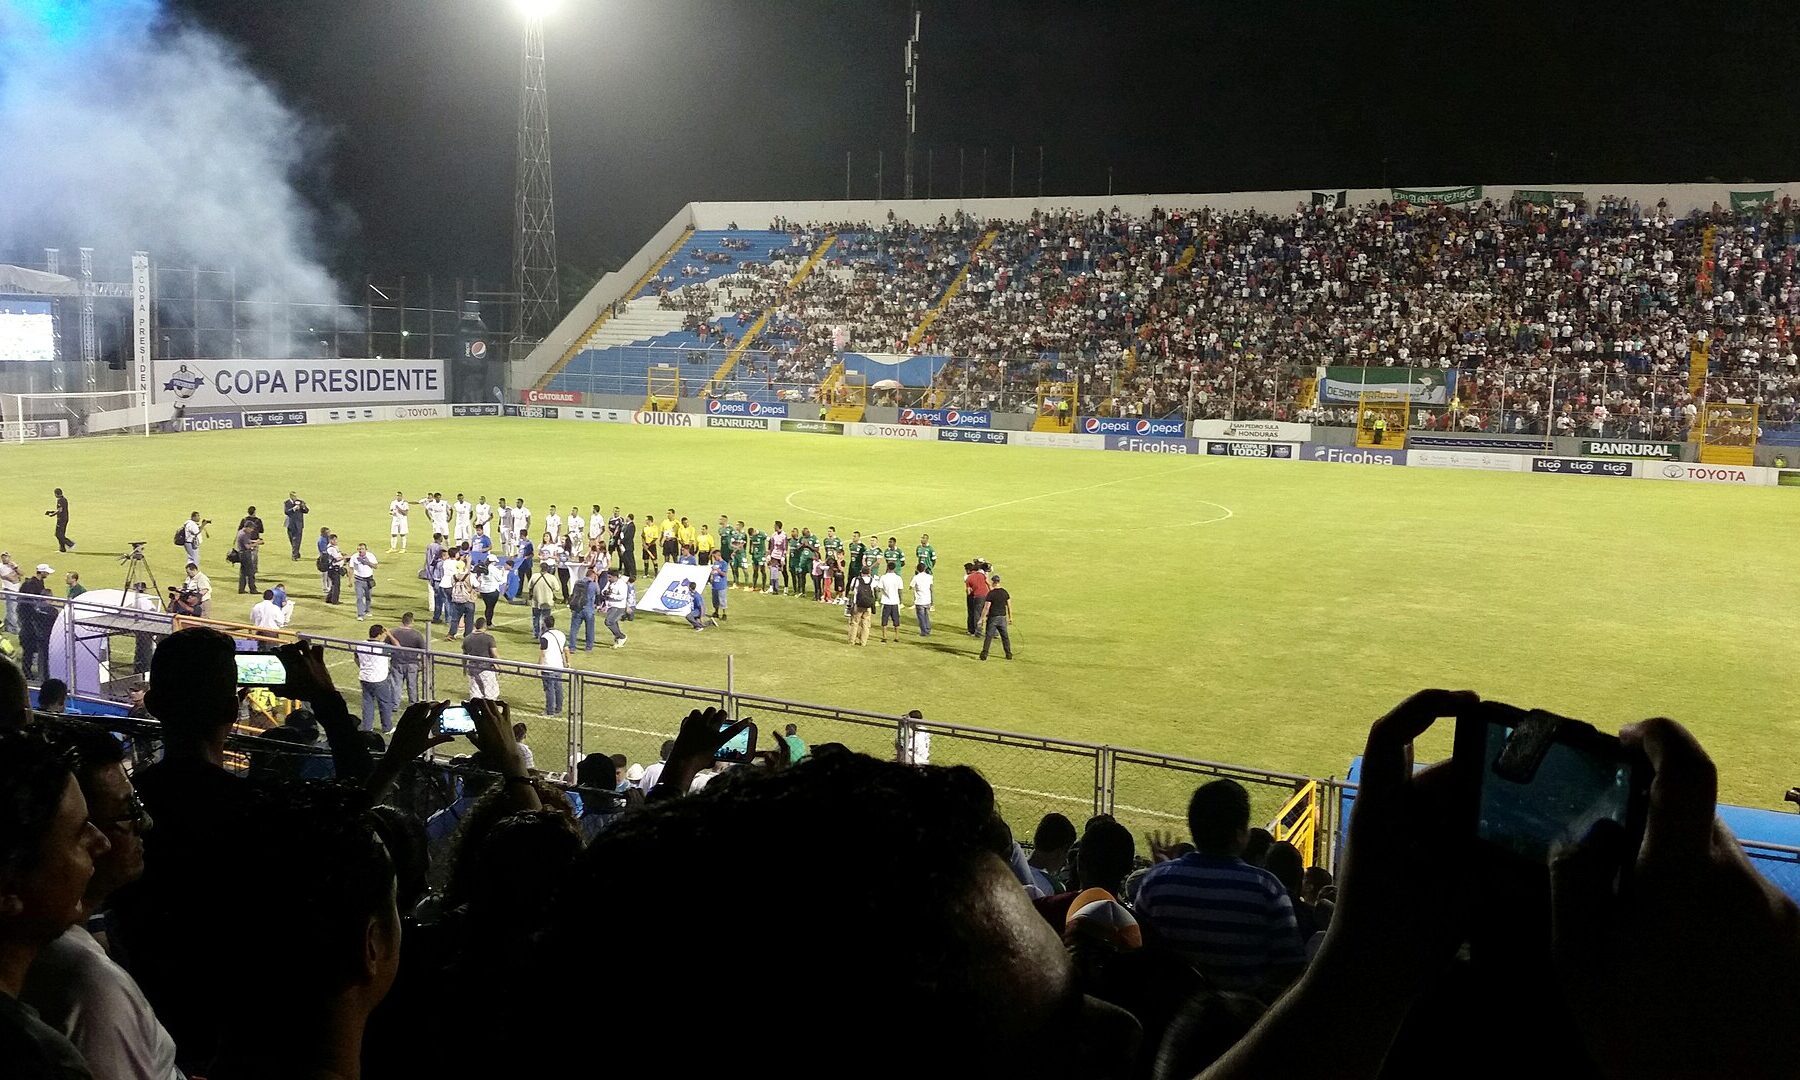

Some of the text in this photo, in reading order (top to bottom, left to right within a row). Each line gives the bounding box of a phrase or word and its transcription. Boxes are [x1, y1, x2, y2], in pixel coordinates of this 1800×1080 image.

[138, 277, 147, 407] COPA PRESIDENTE
[215, 369, 288, 395] COPA
[295, 368, 438, 393] PRESIDENTE
[538, 393, 574, 401] GATORADE
[407, 408, 438, 417] TOYOTA
[721, 404, 786, 415] pepsi pepsi
[183, 417, 233, 431] Ficohsa
[644, 412, 691, 427] DIUNSA
[711, 418, 767, 429] BANRURAL
[960, 415, 987, 425] pepsi
[879, 427, 918, 437] TOYOTA
[1100, 422, 1184, 434] pepsi pepsi
[941, 430, 1004, 444] tigo tigo tigo
[1129, 439, 1187, 454] Ficohsa
[1232, 449, 1268, 457] TODOS
[1590, 443, 1672, 457] BANRURAL
[1327, 449, 1393, 465] Ficohsa
[1537, 459, 1627, 476] tigo tigo tigo
[1687, 468, 1746, 482] TOYOTA
